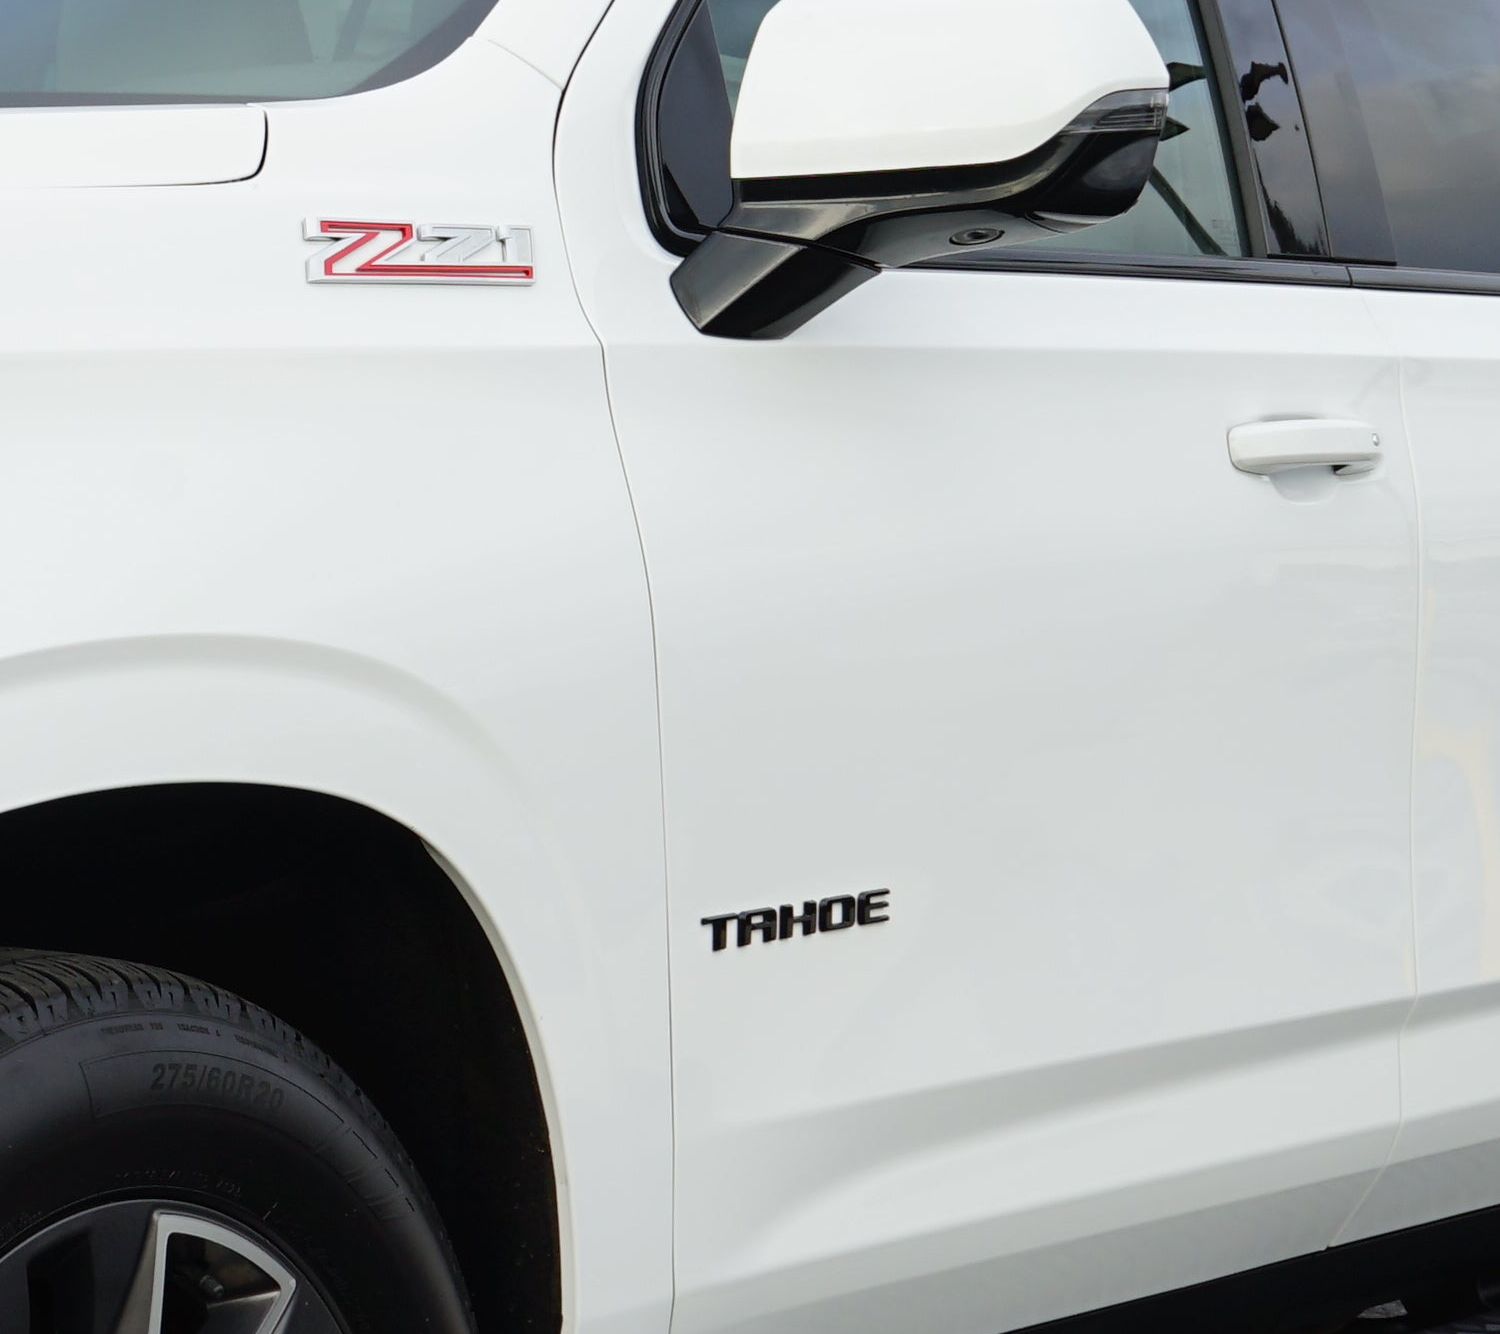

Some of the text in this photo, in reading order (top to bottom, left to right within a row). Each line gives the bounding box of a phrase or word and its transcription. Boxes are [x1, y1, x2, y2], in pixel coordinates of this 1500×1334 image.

[303, 217, 535, 286] Z71
[700, 887, 891, 952] TAHOE
[151, 1064, 285, 1110] 275/60R20
